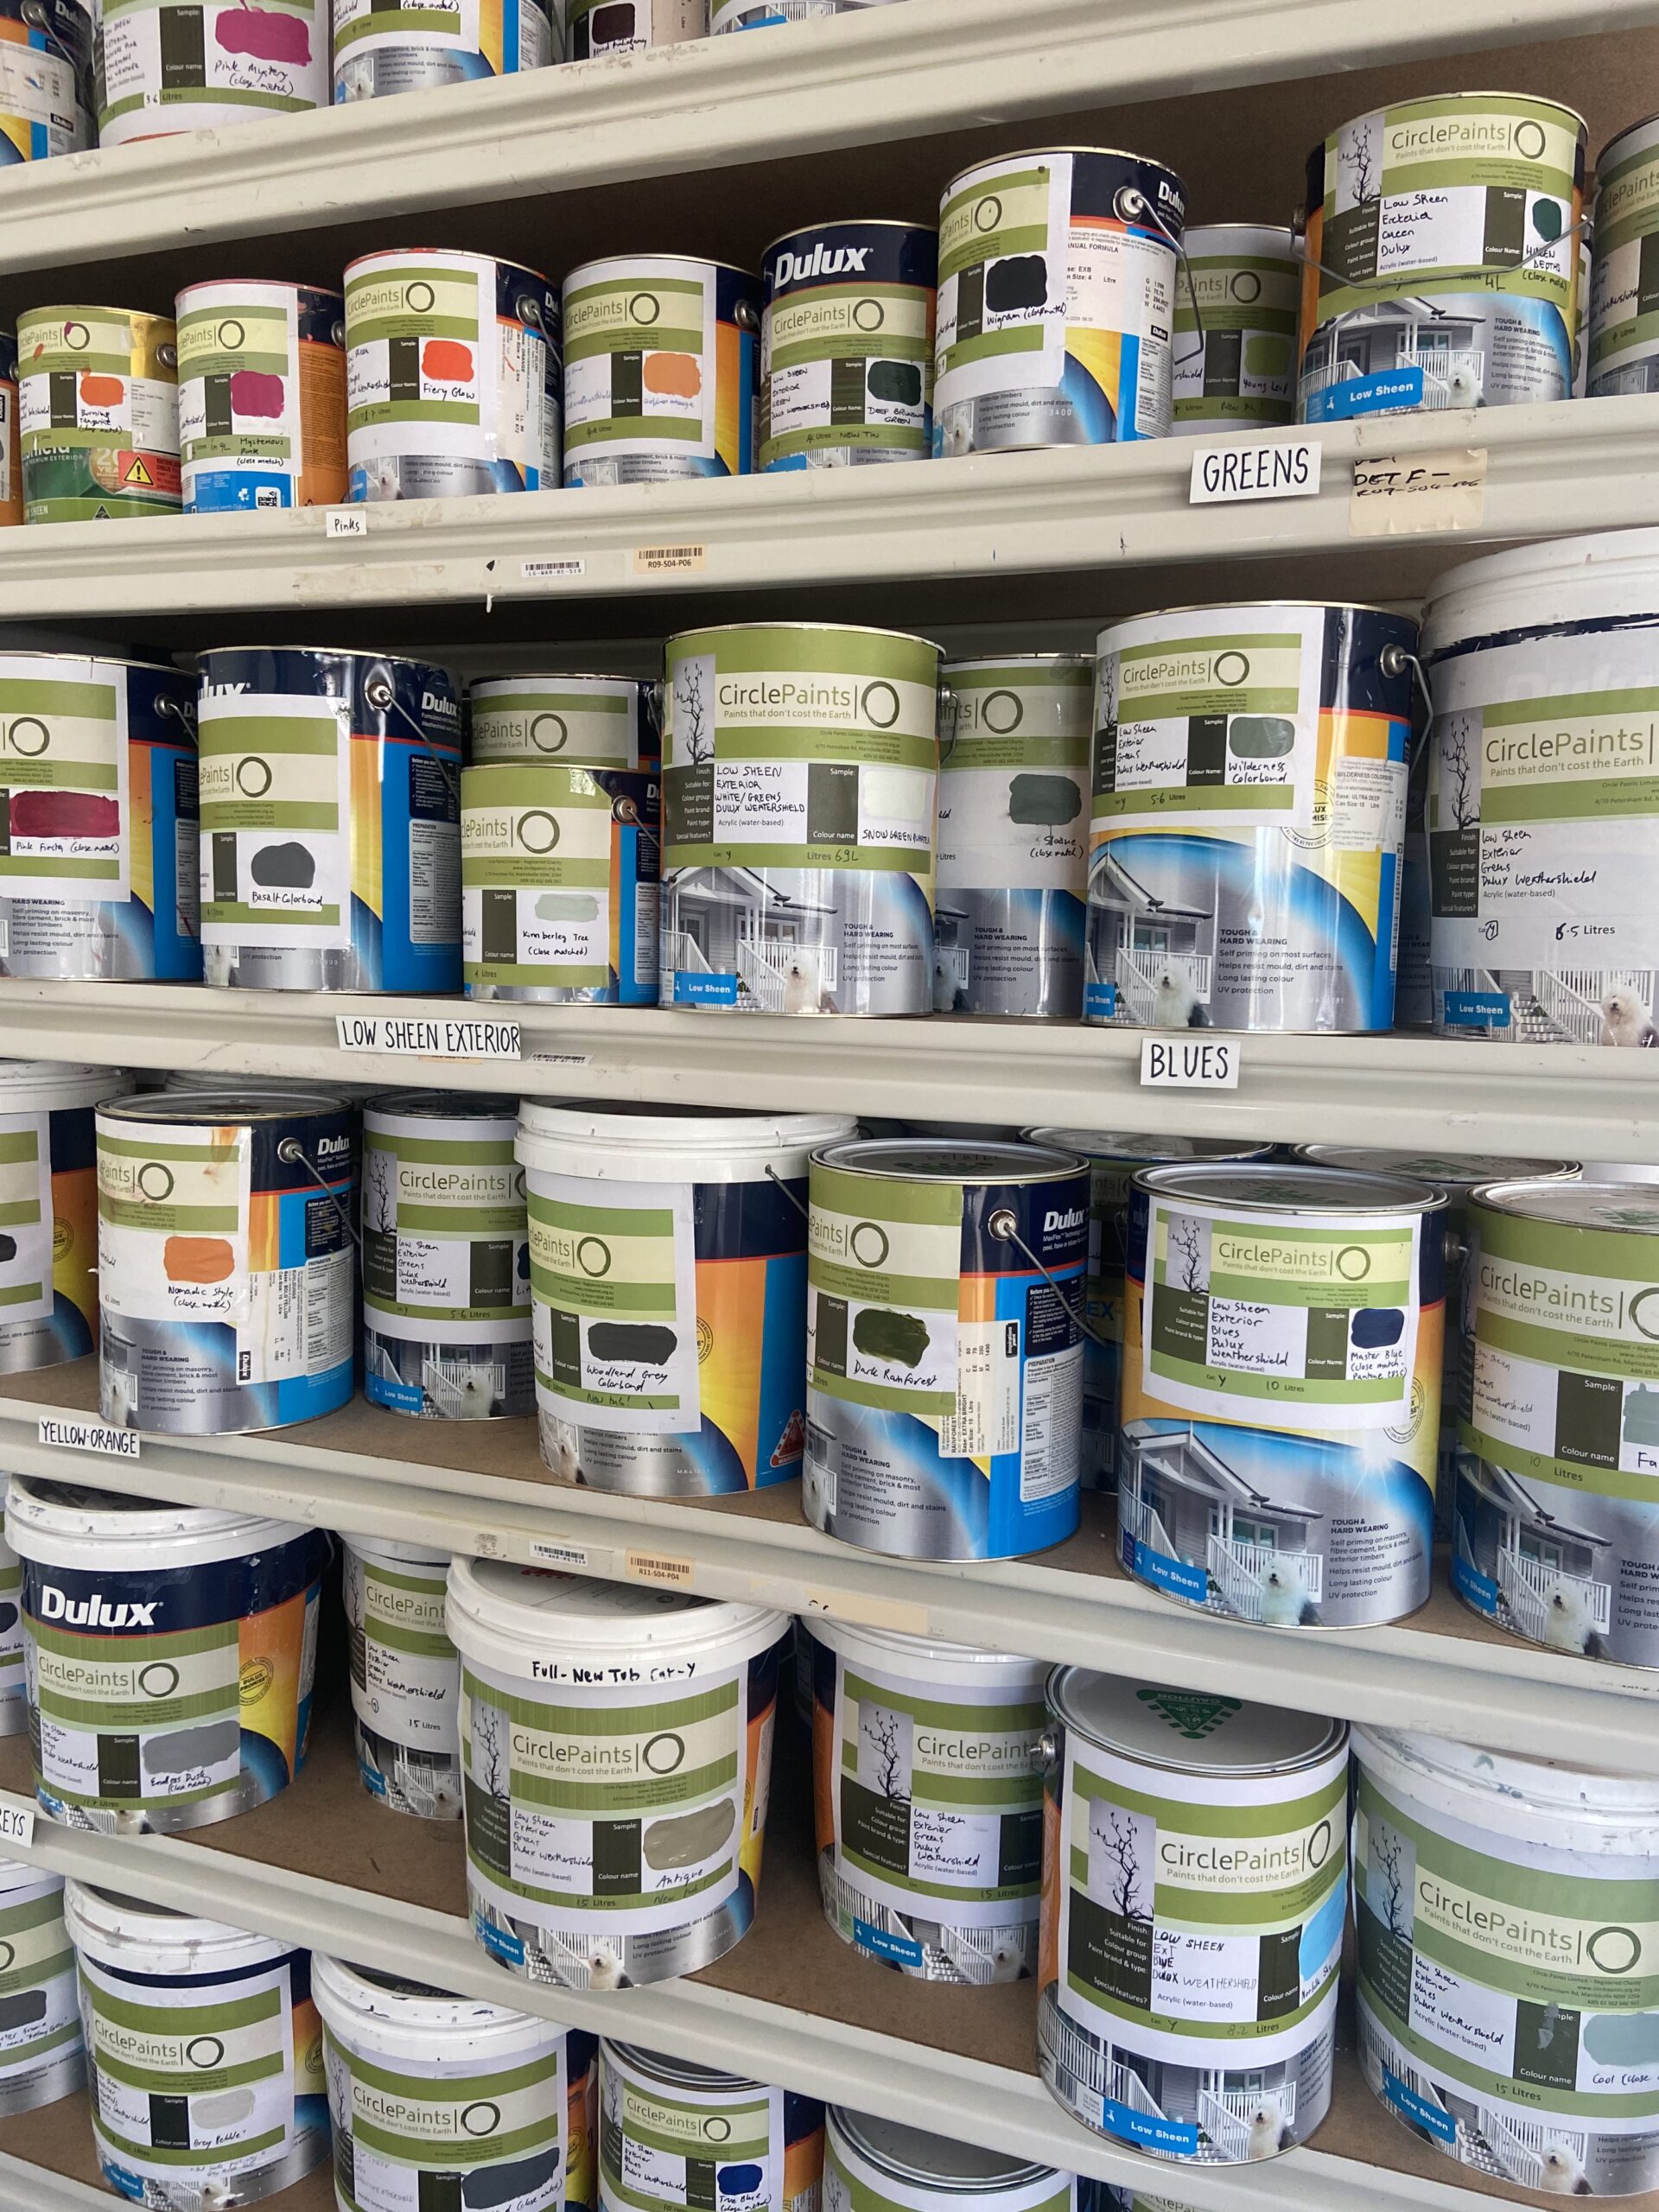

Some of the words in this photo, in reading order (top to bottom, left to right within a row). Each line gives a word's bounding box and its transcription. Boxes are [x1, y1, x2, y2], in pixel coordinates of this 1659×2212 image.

[215, 60, 238, 73] Pink
[248, 64, 289, 82] Mystery
[1392, 123, 1504, 149] CirclePaints
[1158, 181, 1186, 210] Dulux
[1089, 245, 1119, 253] FORMULA
[1382, 244, 1410, 256] Dulux
[775, 244, 868, 289] Dulux
[1534, 260, 1560, 272] DEPTHS
[774, 308, 845, 334] CirclePaints
[988, 312, 1020, 330] Wigram
[423, 384, 448, 401] Fiery
[452, 386, 474, 400] Glow
[1350, 391, 1372, 402] Low
[1375, 383, 1414, 397] Sheen
[1203, 448, 1308, 493] GREENS
[334, 518, 360, 532] Pinks
[648, 559, 691, 568] R09-S04-P06
[1124, 660, 1205, 684] CirclePaints
[719, 682, 850, 707] CirclePaints
[422, 692, 457, 716] Dulux
[1485, 729, 1643, 763] CirclePaints
[716, 766, 739, 776] LOW
[743, 766, 781, 777] SHEEN
[1229, 762, 1286, 772] Wilderness
[1491, 766, 1515, 777] Paints
[1516, 765, 1535, 775] that
[1538, 762, 1565, 773] don't
[1567, 760, 1590, 770] cost
[1592, 759, 1611, 769] the
[1613, 756, 1643, 767] Earth
[716, 779, 762, 790] EXTERIOR
[1232, 772, 1287, 784] Colorbond
[747, 792, 781, 803] GREENS
[1044, 836, 1076, 847] Sloane
[807, 852, 831, 861] Litres
[940, 852, 956, 861] Litres
[252, 891, 279, 906] Basalt
[282, 893, 323, 906] Colorbond
[1484, 890, 1503, 899] Acrylic
[1504, 889, 1555, 899] (water-based)
[1584, 925, 1615, 936] Litres
[1217, 974, 1238, 983] Long
[1241, 975, 1267, 983] lasting
[689, 983, 703, 992] Low
[705, 984, 730, 994] Sheen
[1459, 1004, 1474, 1014] Low
[1476, 1005, 1503, 1015] Sheen
[342, 1020, 377, 1046] LOW
[385, 1021, 439, 1050] SHEEN
[447, 1024, 521, 1054] EXTERIOR
[1150, 1044, 1229, 1079] BLUES
[317, 1136, 351, 1155] Dulux
[399, 1171, 505, 1190] CirclePaints
[1044, 1209, 1086, 1232] Dulux
[1218, 1243, 1327, 1268] CirclePaints
[168, 1286, 207, 1296] Nomadic
[212, 1286, 233, 1299] Style
[1479, 1264, 1613, 1313] CirclePaints
[1211, 1312, 1263, 1327] Exterior
[1211, 1338, 1244, 1351] Dulux
[1211, 1349, 1288, 1366] Weathershield
[1351, 1351, 1380, 1363] Master
[1385, 1349, 1403, 1360] Blue
[587, 1365, 635, 1378] Woodland
[642, 1370, 668, 1382] Grey
[853, 1359, 878, 1376] Dark
[883, 1368, 938, 1386] Rainforest
[1584, 1380, 1618, 1393] Sample:
[397, 1391, 418, 1402] Sheen
[41, 1421, 137, 1454] YELLOW-ORANGE
[842, 1452, 856, 1462] HARD
[858, 1454, 891, 1469] WEARING
[1561, 1445, 1589, 1459] Colour
[1591, 1451, 1615, 1462] name
[1554, 1466, 1583, 1483] Litres
[1355, 1523, 1389, 1533] WEARING
[639, 1567, 680, 1580] R11-S04-P04
[1152, 1563, 1168, 1576] Low
[1170, 1569, 1199, 1589] Sheen
[41, 1584, 158, 1627] Dulux
[365, 1586, 446, 1618] CirclePaint
[39, 1656, 129, 1688] CirclePaints
[573, 1669, 603, 1682] New
[513, 1734, 632, 1764] CirclePaints
[99, 1799, 119, 1808] Litres
[1160, 1843, 1300, 1871] CirclePaints
[914, 1861, 933, 1872] Acrylic
[935, 1866, 977, 1877] (water-based)
[1167, 1868, 1195, 1881] Paints
[1198, 1873, 1217, 1883] that
[1218, 1875, 1243, 1884] don't
[1265, 1872, 1279, 1881] the
[1281, 1868, 1300, 1880] Earth
[657, 1868, 703, 1888] Antique
[1420, 1881, 1572, 1951] CirclePaints
[1154, 1930, 1180, 1944] LOW
[1185, 1940, 1224, 1951] SHEEN
[1424, 1906, 1451, 1928] Paints
[1452, 1920, 1471, 1936] that
[1472, 1930, 1499, 1948] don't
[1501, 1942, 1520, 1953] cost
[1525, 1947, 1542, 1959] the
[1544, 1951, 1572, 1964] Earth
[872, 1936, 888, 1948] Low
[890, 1941, 916, 1958] Sheen
[1154, 1944, 1176, 1956] EXT
[1094, 1977, 1114, 1992] Special
[1116, 1985, 1147, 2005] features?
[1183, 1979, 1256, 1990] WEATHERSHIELD
[1256, 2023, 1279, 2034] Litres
[1414, 2009, 1435, 2025] Acrylic
[1436, 2020, 1487, 2052] (water-based)
[94, 2018, 177, 2057] CirclePaints
[1520, 2069, 1546, 2081] Colour
[1548, 2075, 1572, 2085] name
[1512, 2086, 1541, 2101] Litres
[353, 2086, 451, 2126] CirclePaints
[626, 2096, 696, 2131] CirclePaints
[1401, 2093, 1419, 2109] Low
[1420, 2107, 1448, 2131] Sheen
[1131, 2122, 1153, 2136] Low
[1156, 2129, 1190, 2144] Sheen
